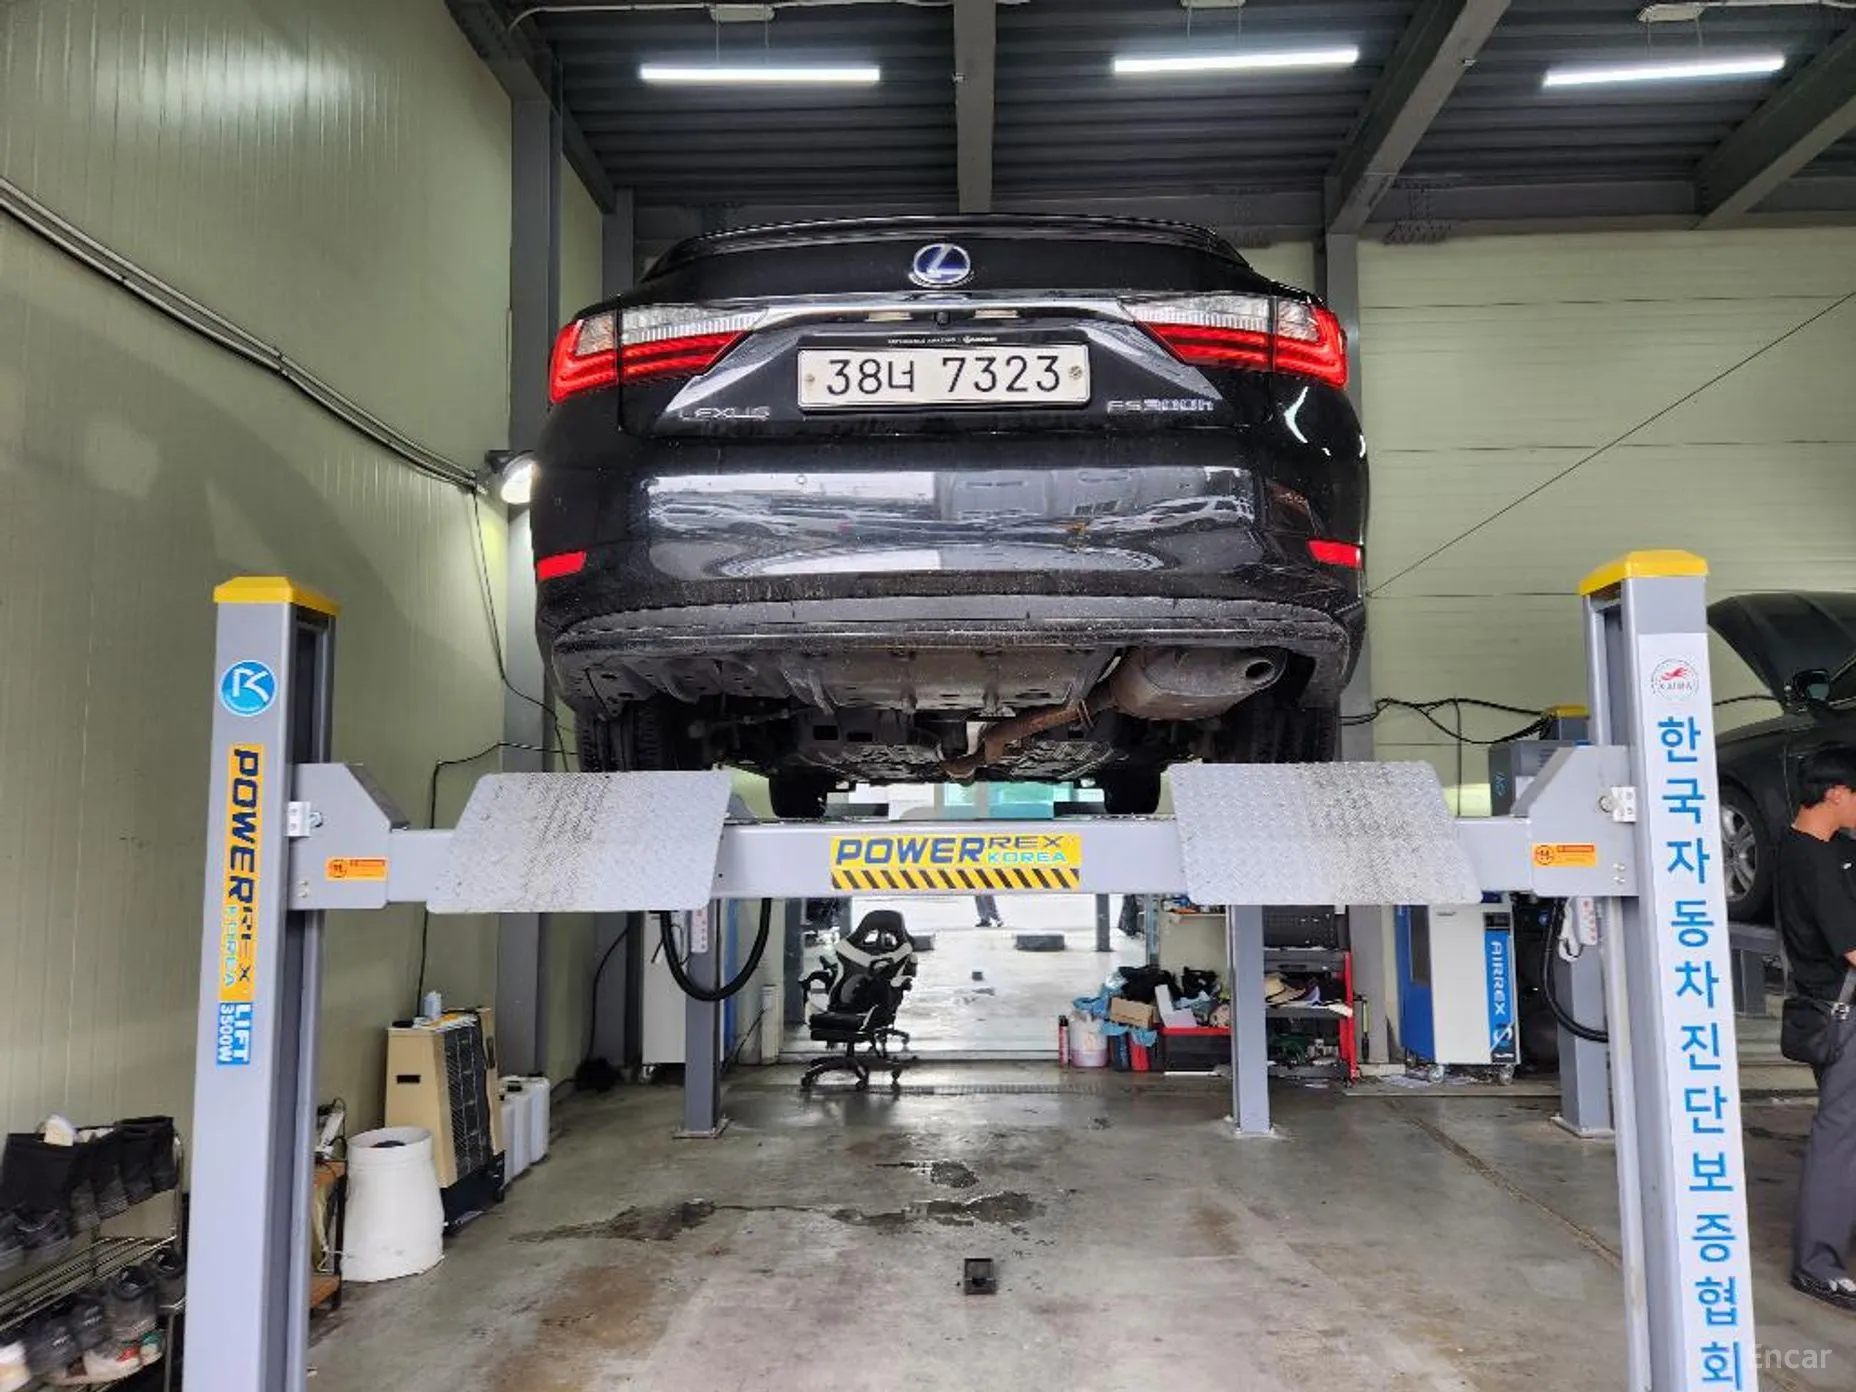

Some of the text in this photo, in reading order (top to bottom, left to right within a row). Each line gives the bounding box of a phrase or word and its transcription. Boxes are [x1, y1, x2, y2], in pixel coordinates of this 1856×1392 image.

[826, 355, 1061, 395] 38너 7323
[229, 748, 259, 904] POWER
[988, 835, 1064, 849] REX
[836, 837, 985, 865] POWER
[987, 851, 1067, 864] KOREA
[1491, 941, 1506, 1015] AIRREX
[217, 1004, 235, 1063] 3500W
[234, 1003, 251, 1062] LIFT
